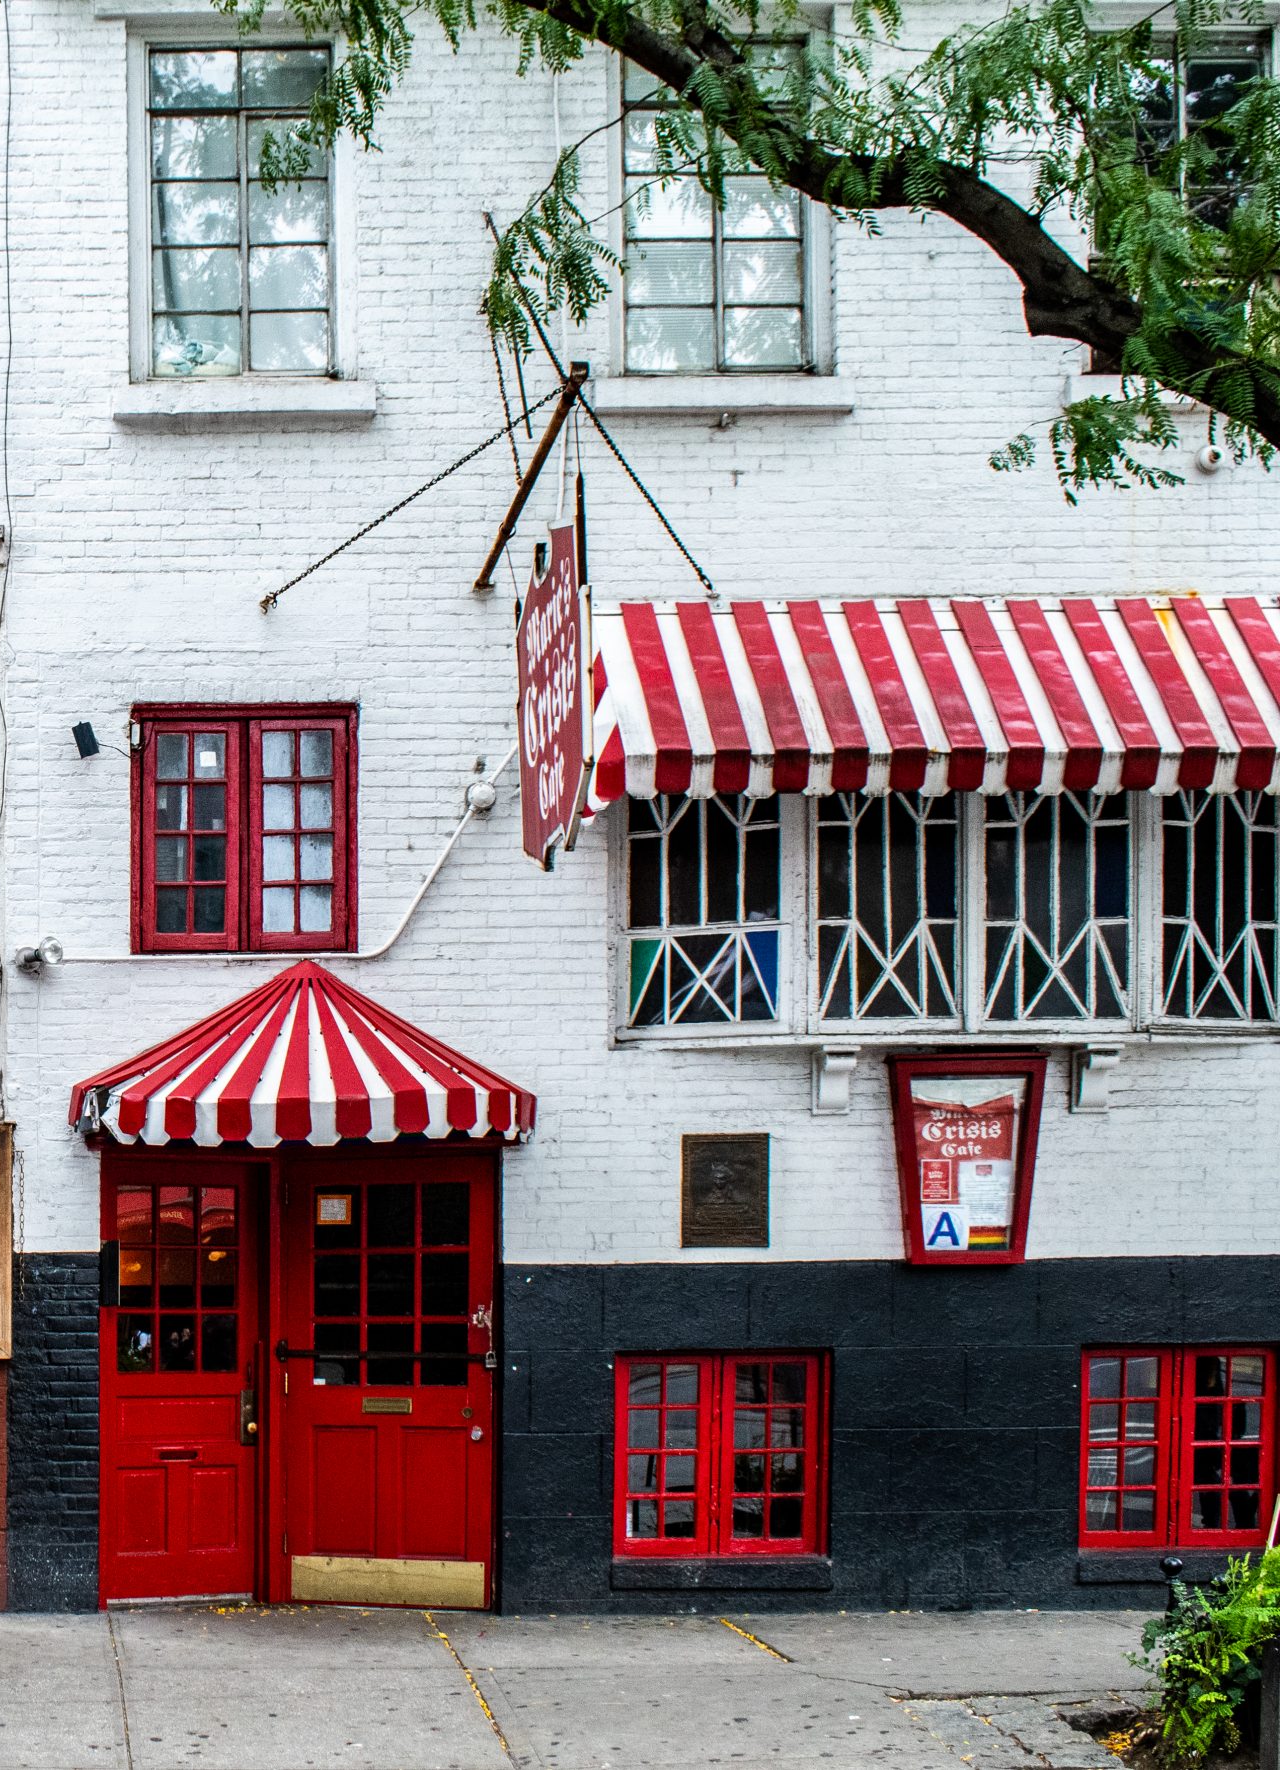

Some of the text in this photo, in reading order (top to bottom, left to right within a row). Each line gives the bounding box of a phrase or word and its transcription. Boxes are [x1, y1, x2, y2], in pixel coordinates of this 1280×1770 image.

[527, 556, 571, 678] Marie's
[524, 621, 576, 768] Crisis
[922, 1121, 1001, 1142] Crisis
[927, 1211, 960, 1246] A
